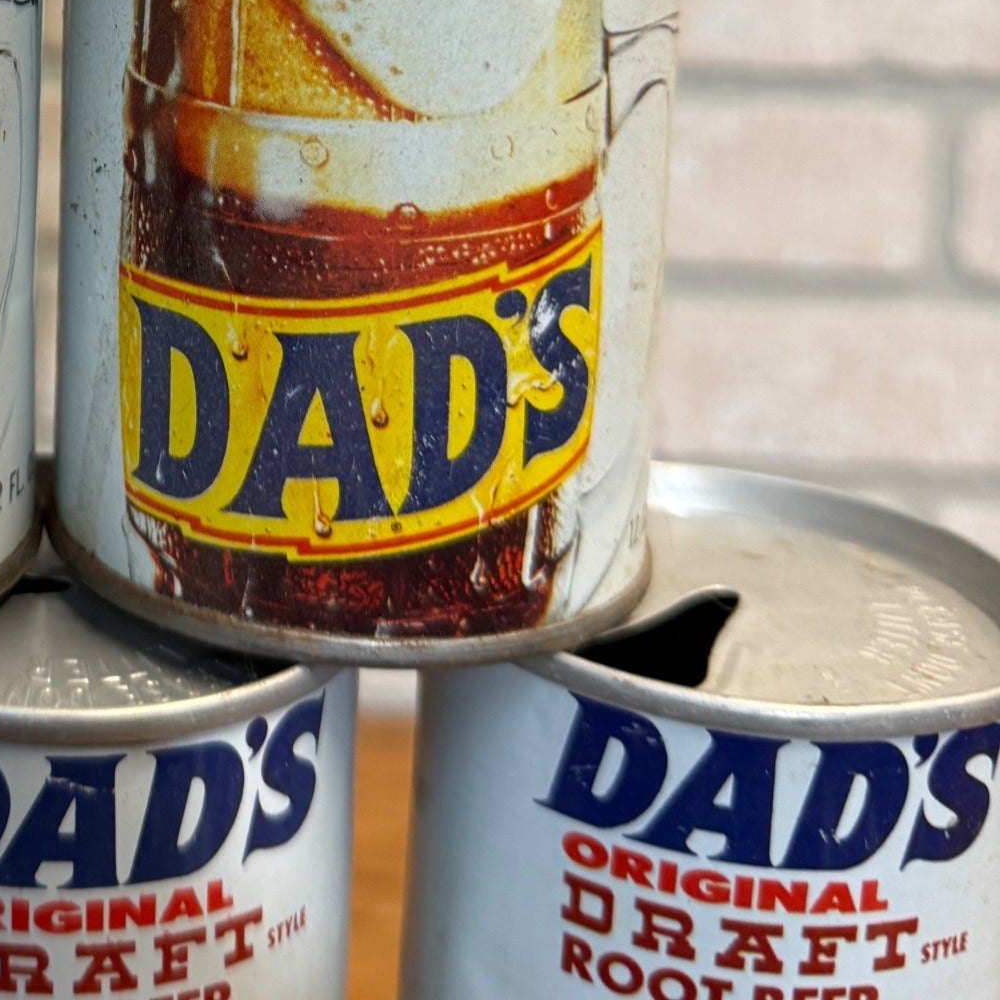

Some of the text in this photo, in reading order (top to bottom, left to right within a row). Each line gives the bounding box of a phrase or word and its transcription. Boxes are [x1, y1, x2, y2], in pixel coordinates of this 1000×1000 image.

[131, 254, 593, 521] DAD'S
[533, 690, 1000, 871] DAD'S
[561, 872, 969, 976] DRAFT STYLE
[562, 832, 888, 915] ORIGINAL
[267, 905, 306, 949] STYLE
